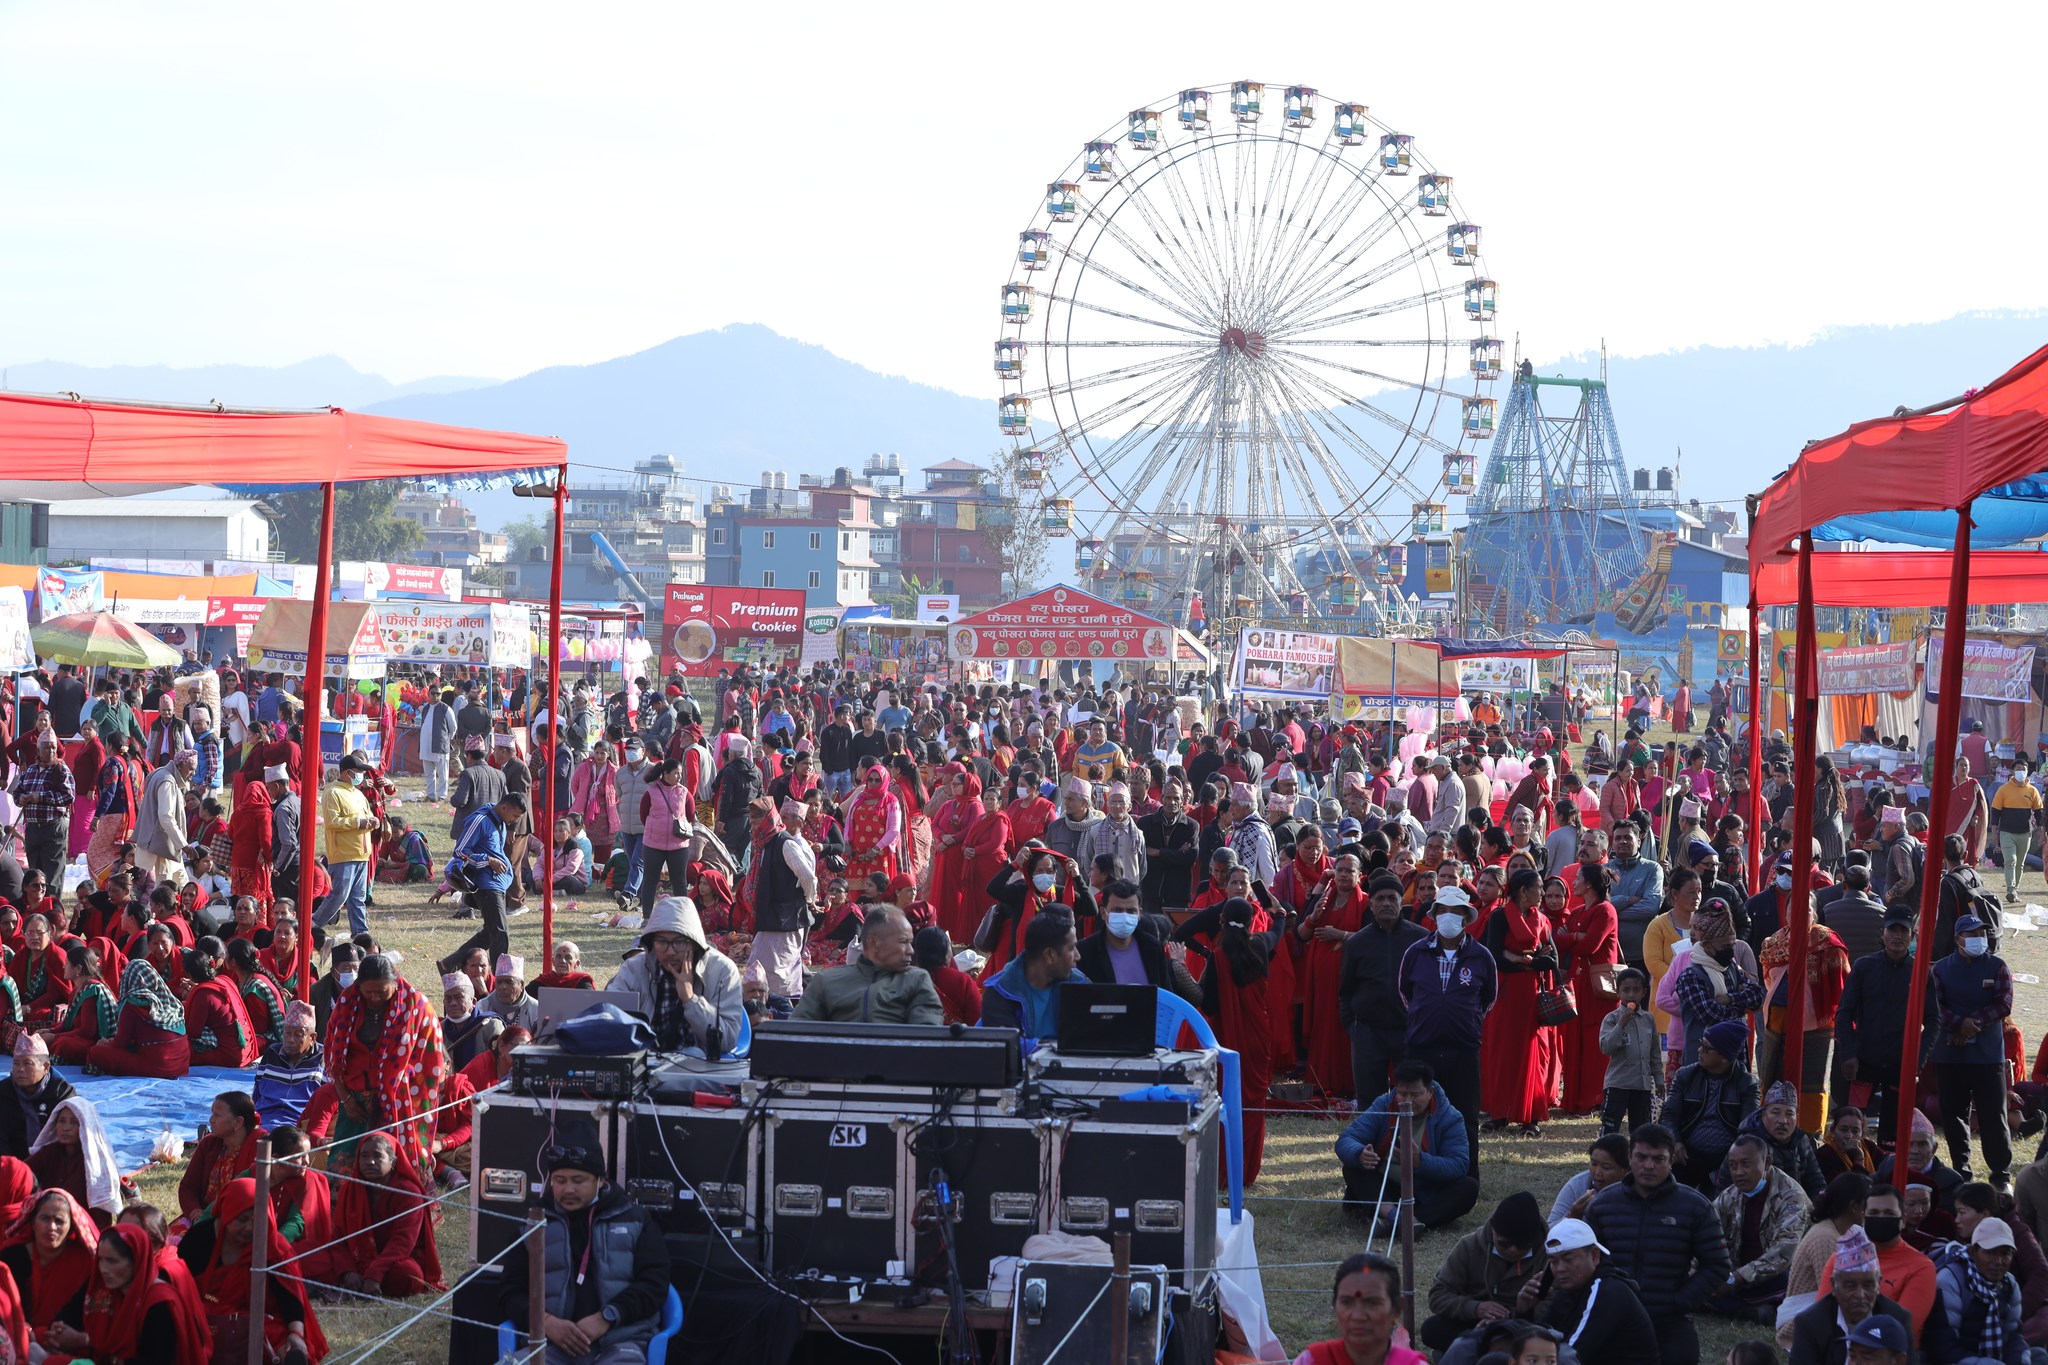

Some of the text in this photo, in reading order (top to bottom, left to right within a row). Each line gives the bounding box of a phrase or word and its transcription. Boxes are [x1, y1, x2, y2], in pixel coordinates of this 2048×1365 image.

[673, 590, 704, 602] Pashupati
[731, 602, 799, 617] Premium
[1031, 603, 1090, 615] न्यू पोखरा
[386, 613, 418, 626] फेमस
[456, 615, 484, 628] गोला
[987, 612, 1021, 624] फेमस
[1052, 616, 1077, 624] एण्ड
[1081, 614, 1108, 624] पानी
[1111, 613, 1133, 625] पुरी
[752, 621, 797, 632] Cookies
[982, 630, 997, 640] न्यू
[999, 629, 1026, 638] पोखरा
[1029, 629, 1056, 639] फेमस
[1078, 630, 1096, 638] एण्ड
[1099, 629, 1120, 638] पानी
[1123, 629, 1139, 640] पुरी
[267, 650, 291, 660] पोखरा
[1246, 648, 1336, 664] POKHARA FAMOUS BUB
[1365, 697, 1391, 706] पोखर
[835, 1126, 862, 1145] SK
